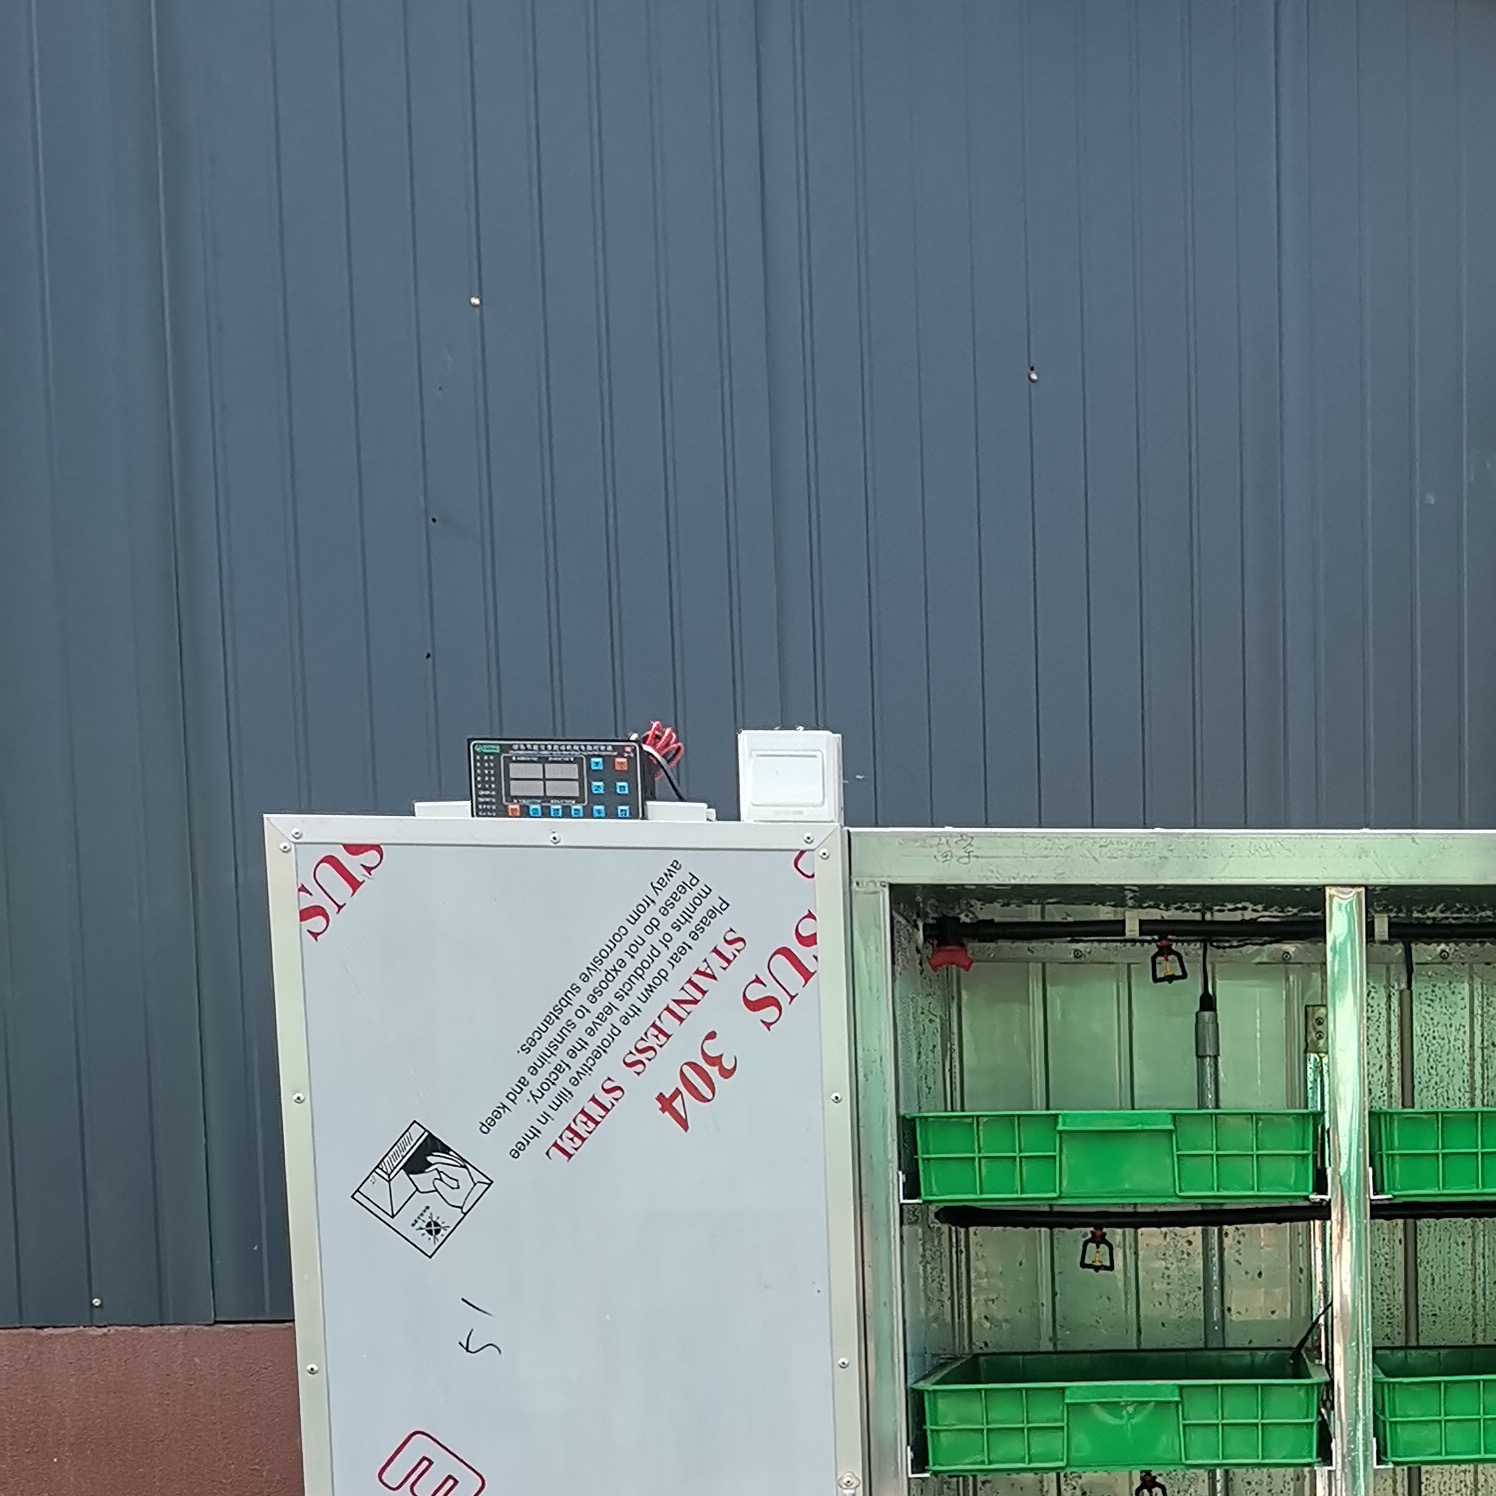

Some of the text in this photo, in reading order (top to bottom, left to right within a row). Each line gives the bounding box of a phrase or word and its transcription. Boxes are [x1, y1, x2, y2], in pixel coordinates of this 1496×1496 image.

[479, 871, 700, 1135] Please do not expose to sunshine and keep
[509, 895, 730, 1160] Please tear down the protective film in three
[516, 859, 682, 1055] away from corrosive substances.
[526, 883, 713, 1105] months of products leave the factory.
[545, 927, 747, 1162] STAINLESS STEEL
[655, 1030, 738, 1133] 304
